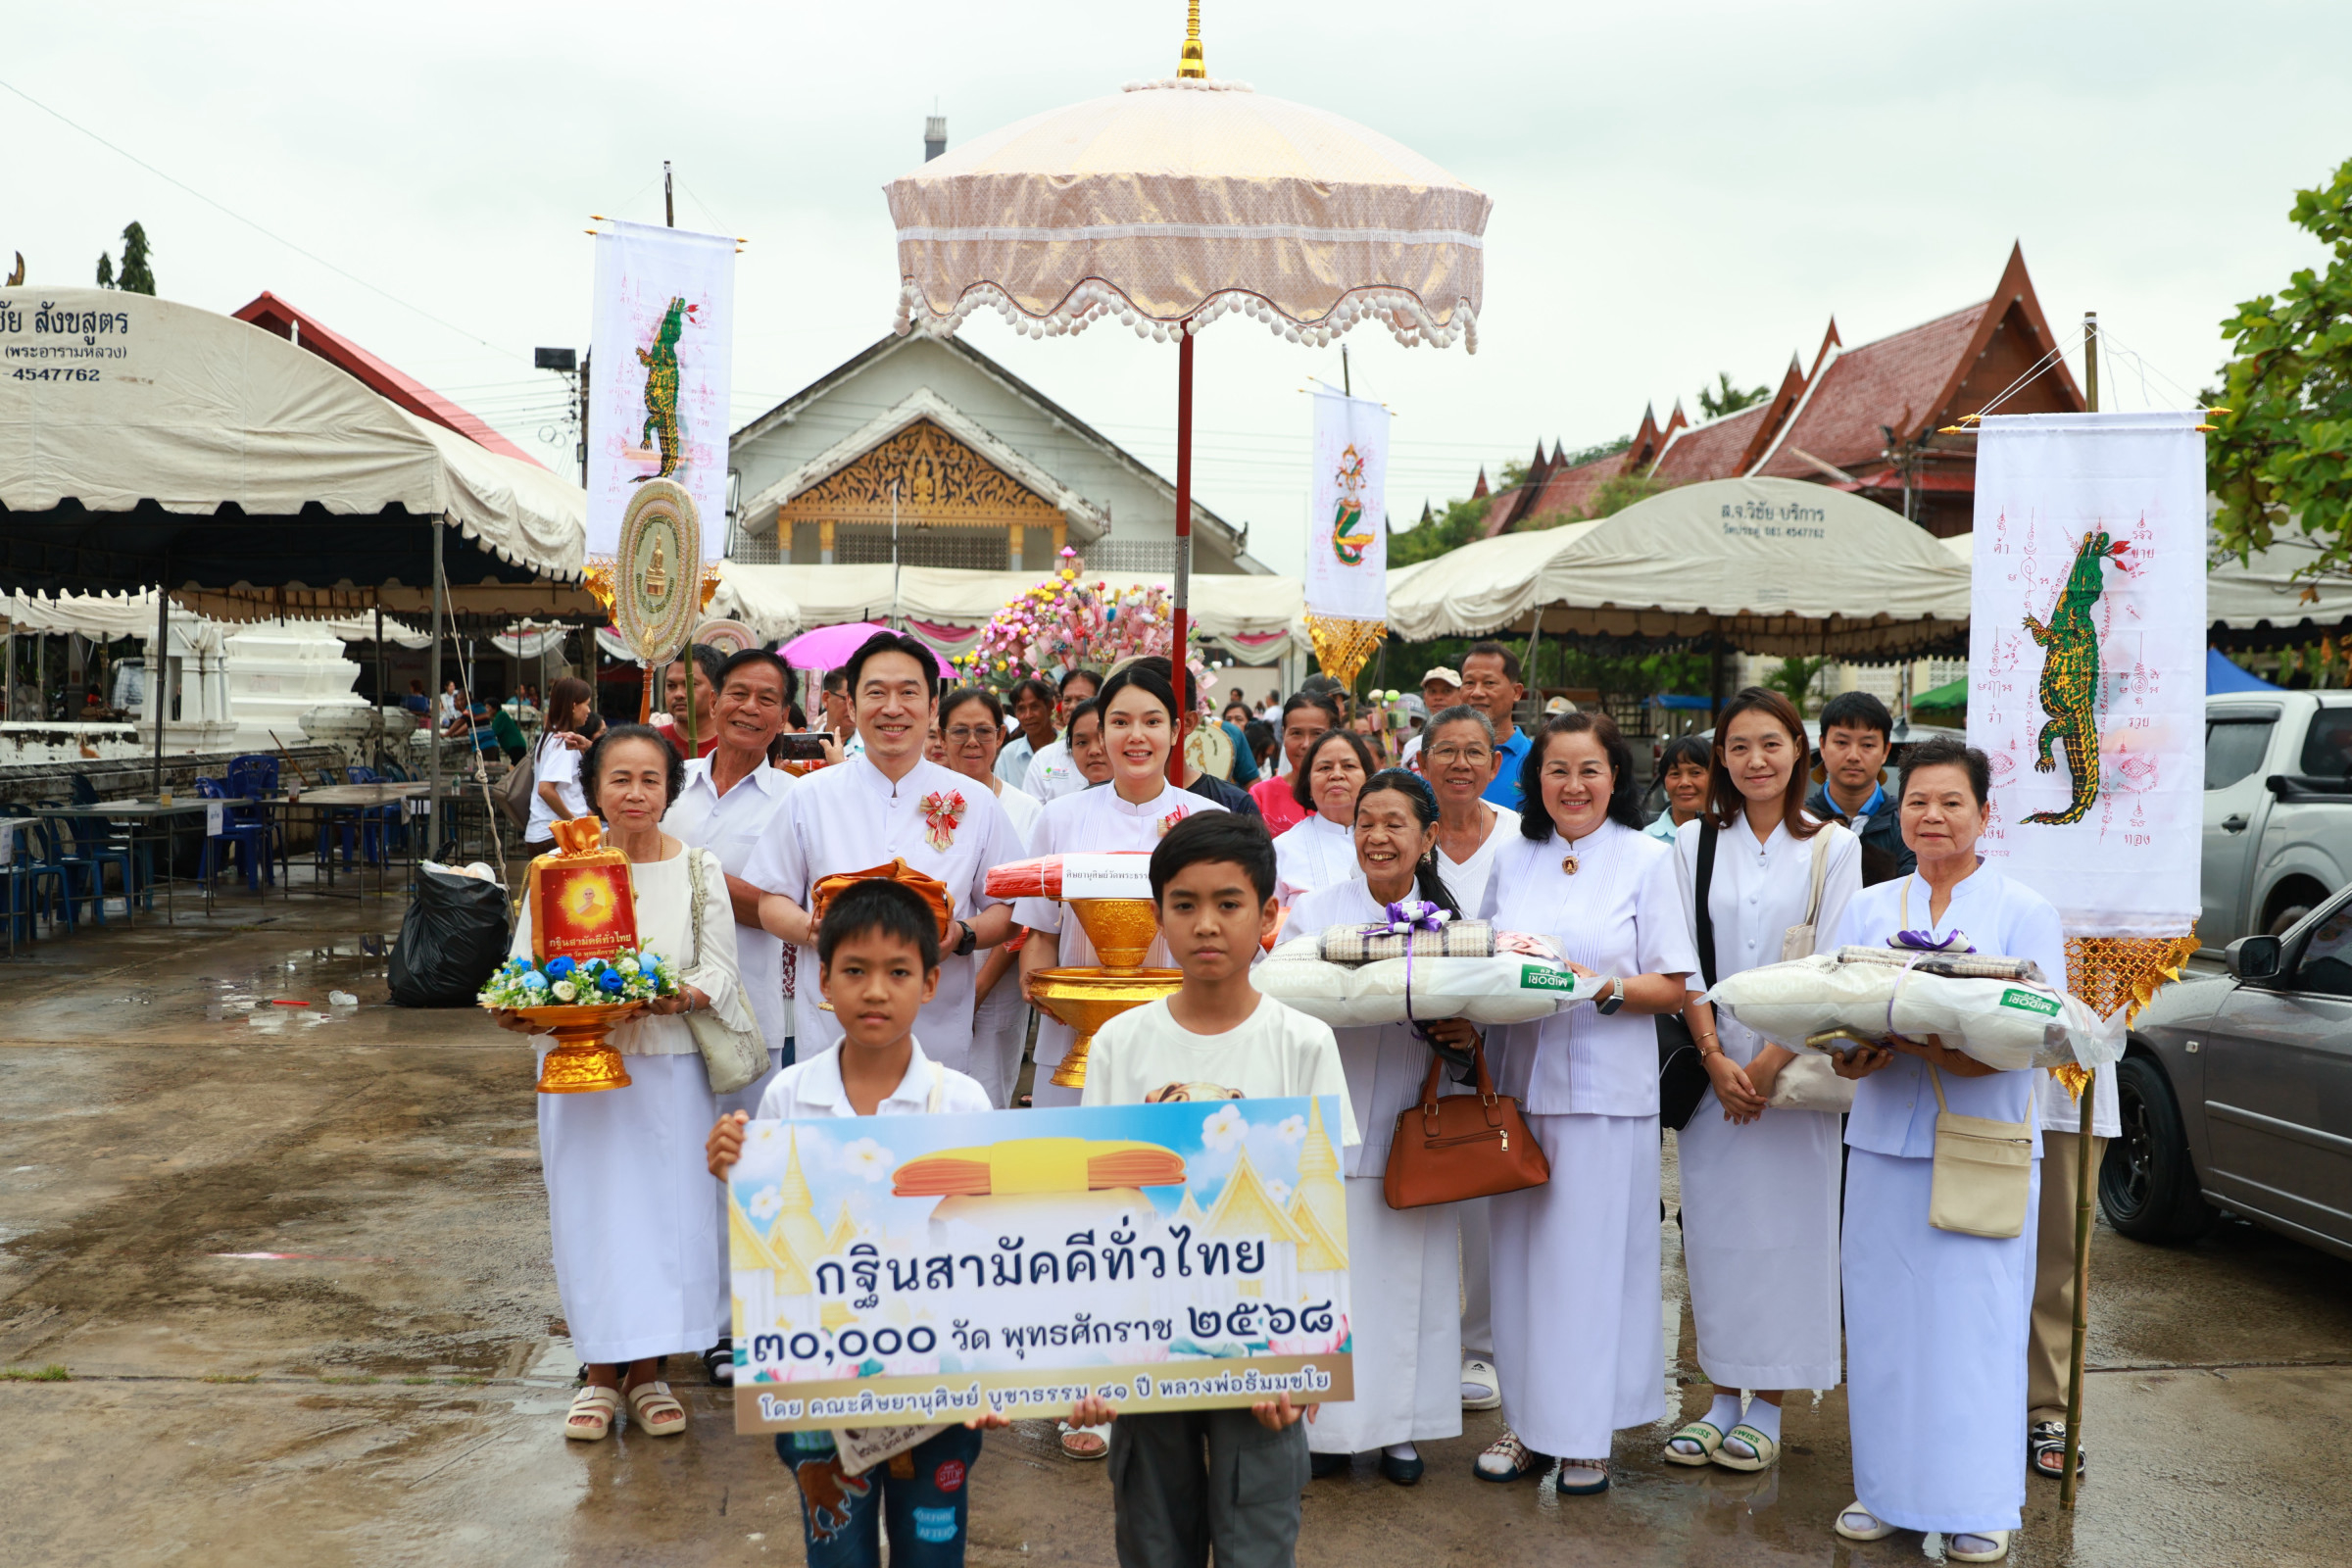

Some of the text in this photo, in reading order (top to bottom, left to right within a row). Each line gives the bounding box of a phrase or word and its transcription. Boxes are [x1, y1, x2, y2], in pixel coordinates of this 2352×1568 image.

[35, 300, 128, 346] สังขสูตร
[5, 346, 127, 360] (พระอารามหลวง)
[1780, 502, 1825, 521] บริการ
[2129, 717, 2150, 728] รวย
[1066, 869, 1149, 881] ศิษยานุศิษย์วัดพระธรร
[549, 931, 631, 950] กฐินสามัคคีทั่วไทย
[1528, 974, 1568, 988] MIDORI
[2008, 995, 2052, 1011] MIDORI
[815, 1215, 1265, 1310] กฐินสามัคคีทั่วไทย
[754, 1299, 1334, 1366] ๓๐,๐๐๐ วัด พุทธศักราช ๒๕๖๘
[761, 1396, 802, 1418] โดย
[811, 1384, 980, 1416] คณะศิษยานุศิษย์
[988, 1385, 1089, 1412] บูชาธรรม
[1136, 1374, 1152, 1397] ปี
[1160, 1366, 1330, 1396] หลวงพ่อธัมมชโย
[1731, 1429, 1761, 1444] SWISS
[940, 1467, 962, 1482] STOP
